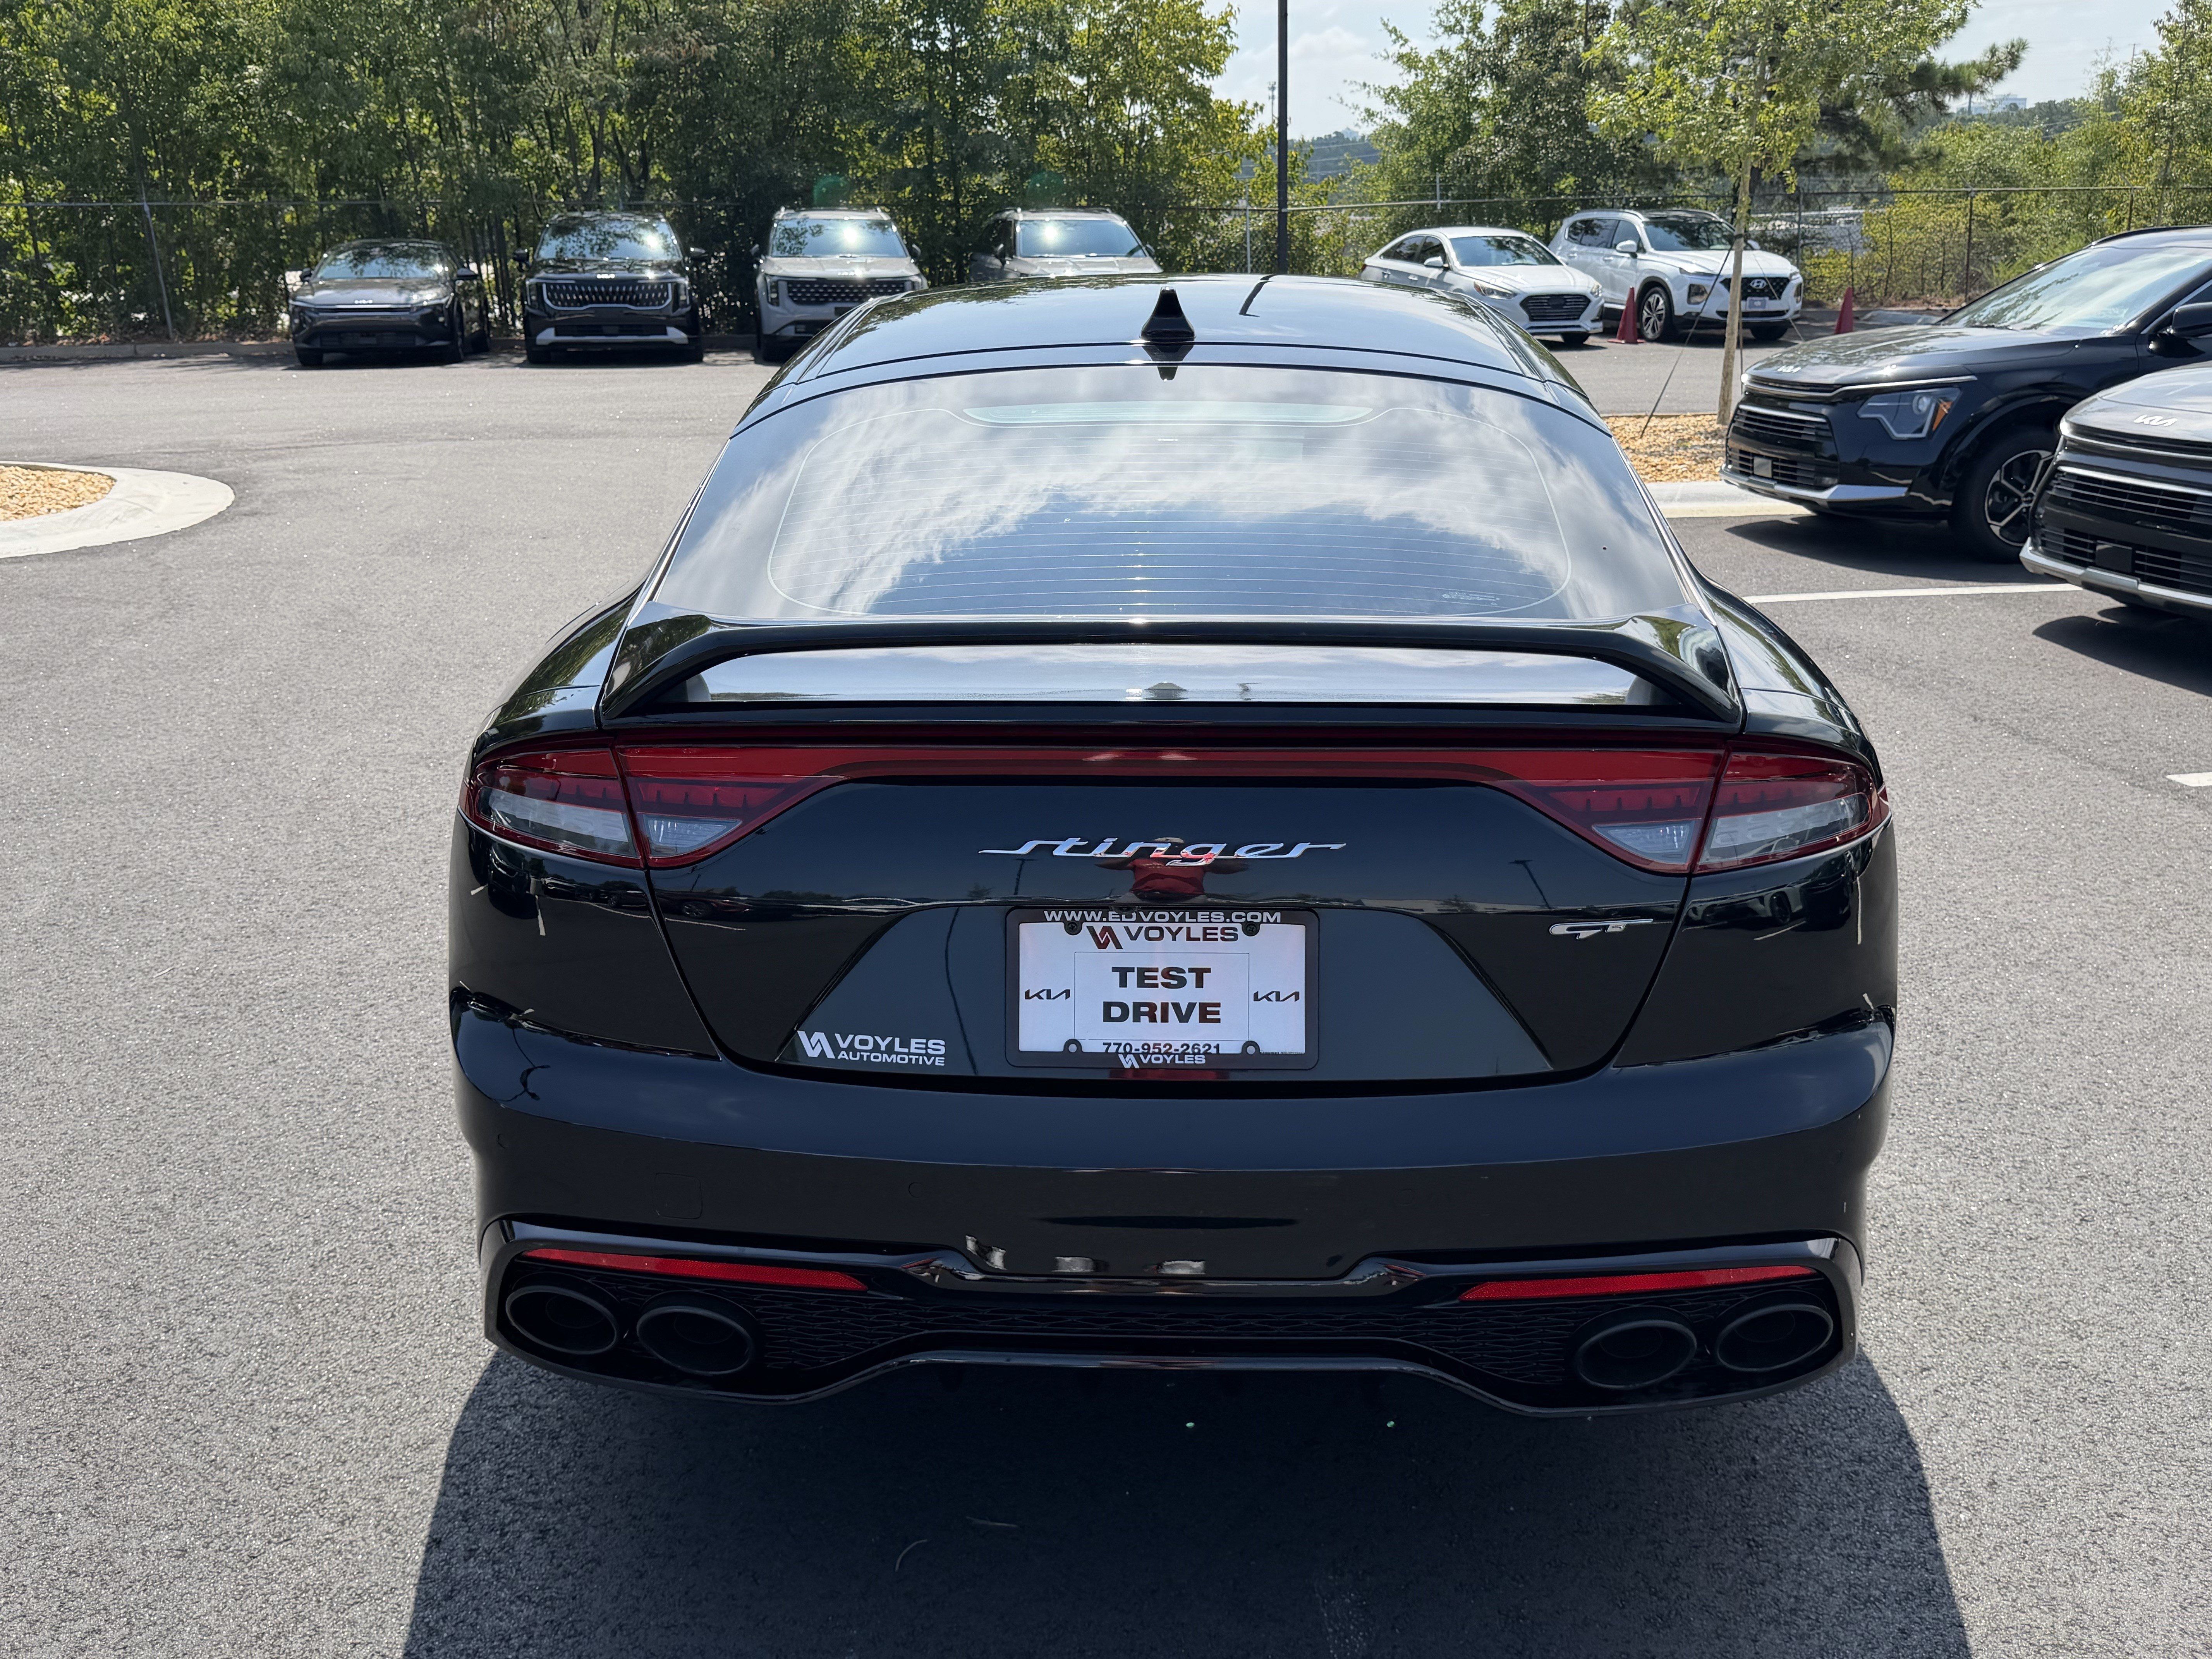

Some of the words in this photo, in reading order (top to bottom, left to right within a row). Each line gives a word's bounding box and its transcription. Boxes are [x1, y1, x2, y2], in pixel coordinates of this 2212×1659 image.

[978, 837, 1347, 866] stinger
[1044, 910, 1281, 923] WWW.EDVOYLES.COM
[1123, 926, 1239, 942] VOYLES
[1549, 918, 1654, 940] GT
[1111, 966, 1211, 989] TEST
[1024, 989, 1071, 1000] KIA
[1253, 990, 1300, 1002] KIA
[1103, 1001, 1221, 1024] DRIVE
[834, 1033, 946, 1055] VOYLES
[1102, 1042, 1221, 1053] 770-952-2621
[837, 1050, 945, 1066] AUTOMOTIVE
[1139, 1054, 1206, 1064] VOYLES
